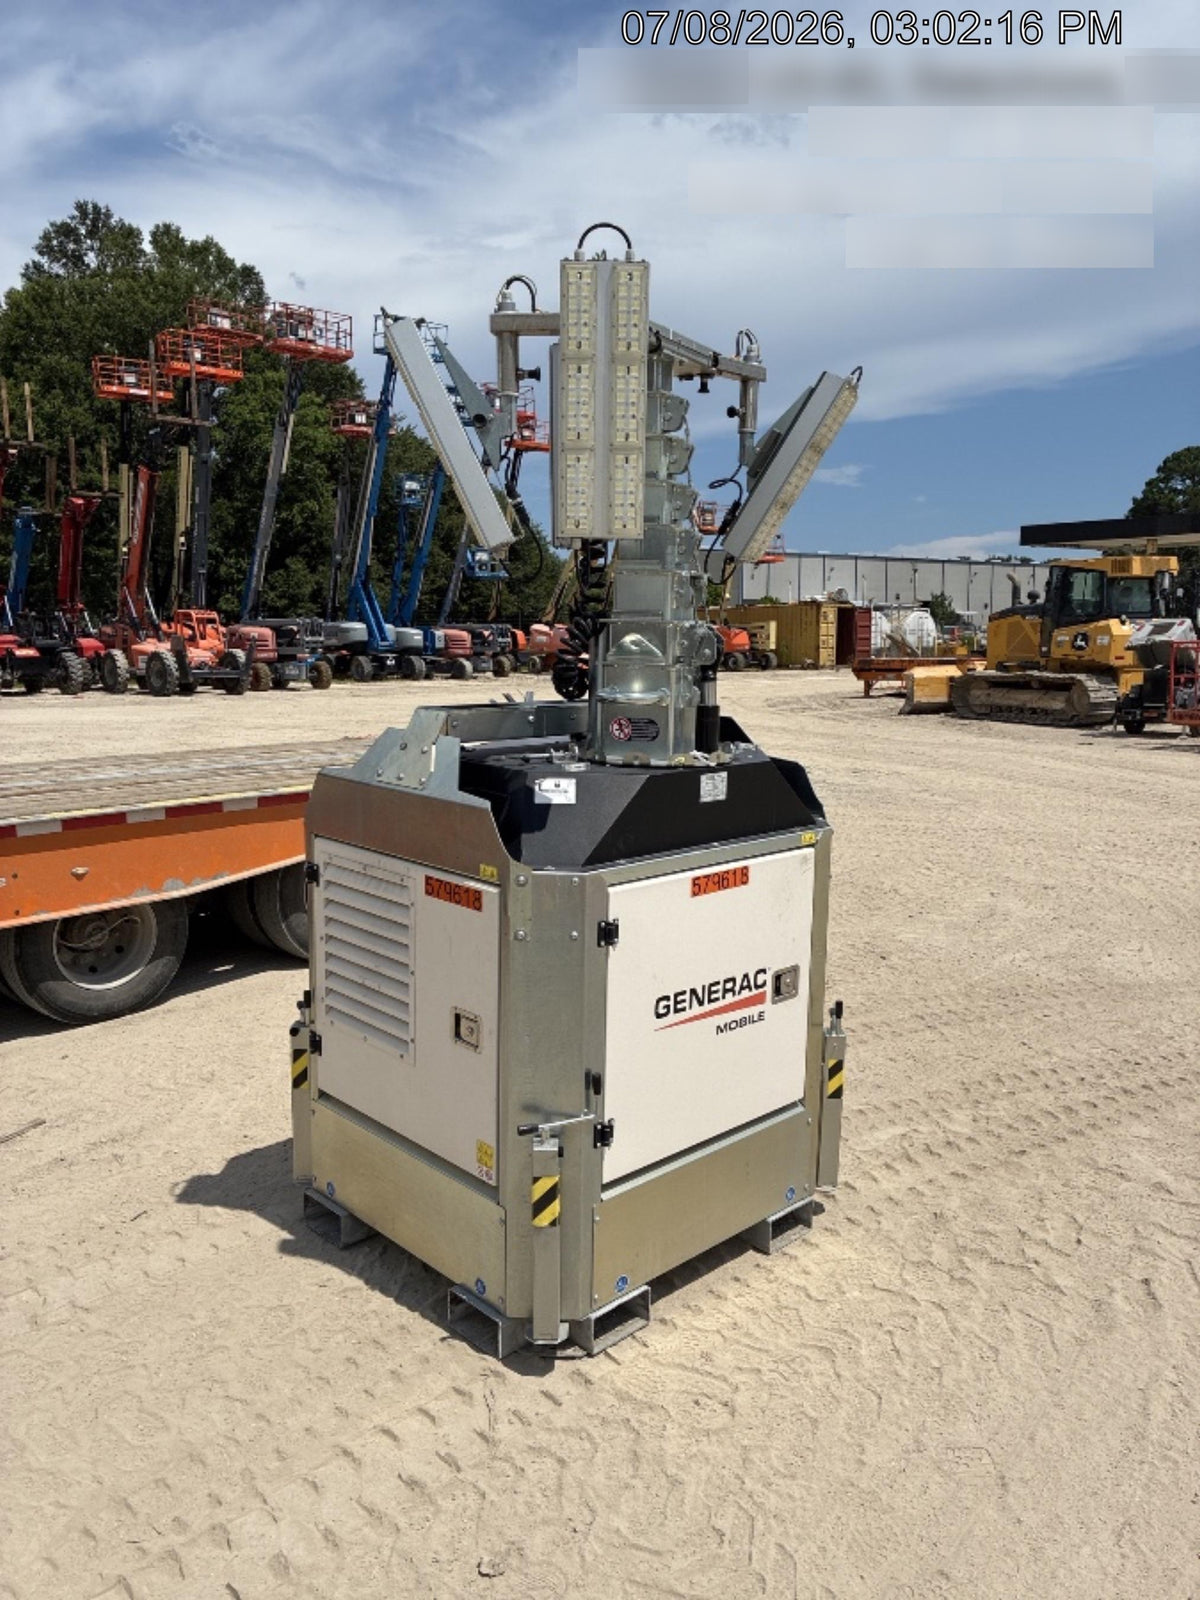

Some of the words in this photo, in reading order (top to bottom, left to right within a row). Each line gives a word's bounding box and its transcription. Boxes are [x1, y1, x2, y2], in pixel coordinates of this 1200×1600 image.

[424, 875, 483, 912] 579618
[691, 866, 749, 896] 579618
[654, 968, 767, 1020] GENERAC
[715, 1011, 766, 1036] MOBILE
